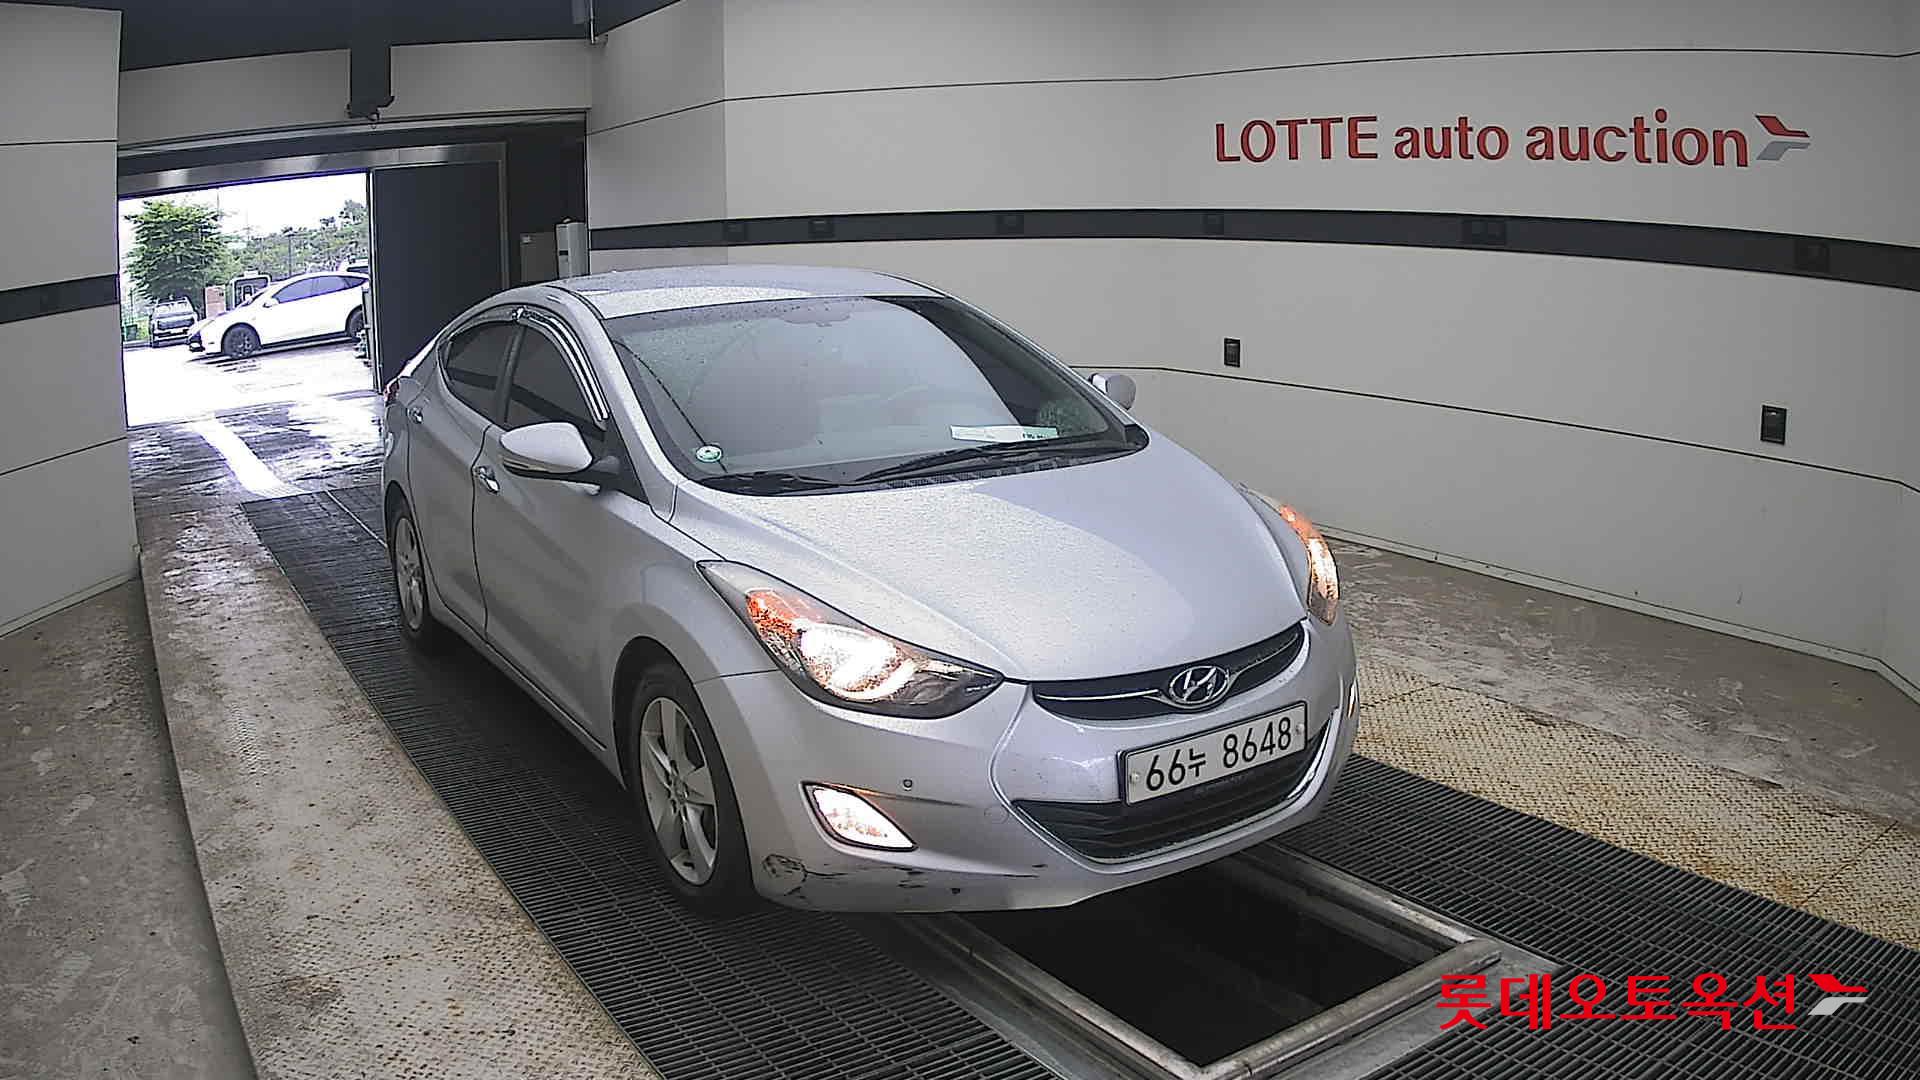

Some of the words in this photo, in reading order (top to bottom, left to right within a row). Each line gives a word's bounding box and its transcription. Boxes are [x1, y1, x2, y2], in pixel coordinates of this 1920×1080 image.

[1216, 116, 1378, 161] LOTTE
[1393, 117, 1510, 161] auto
[1525, 109, 1749, 168] auction
[1146, 748, 1206, 791] 66누
[1223, 716, 1292, 769] 8648
